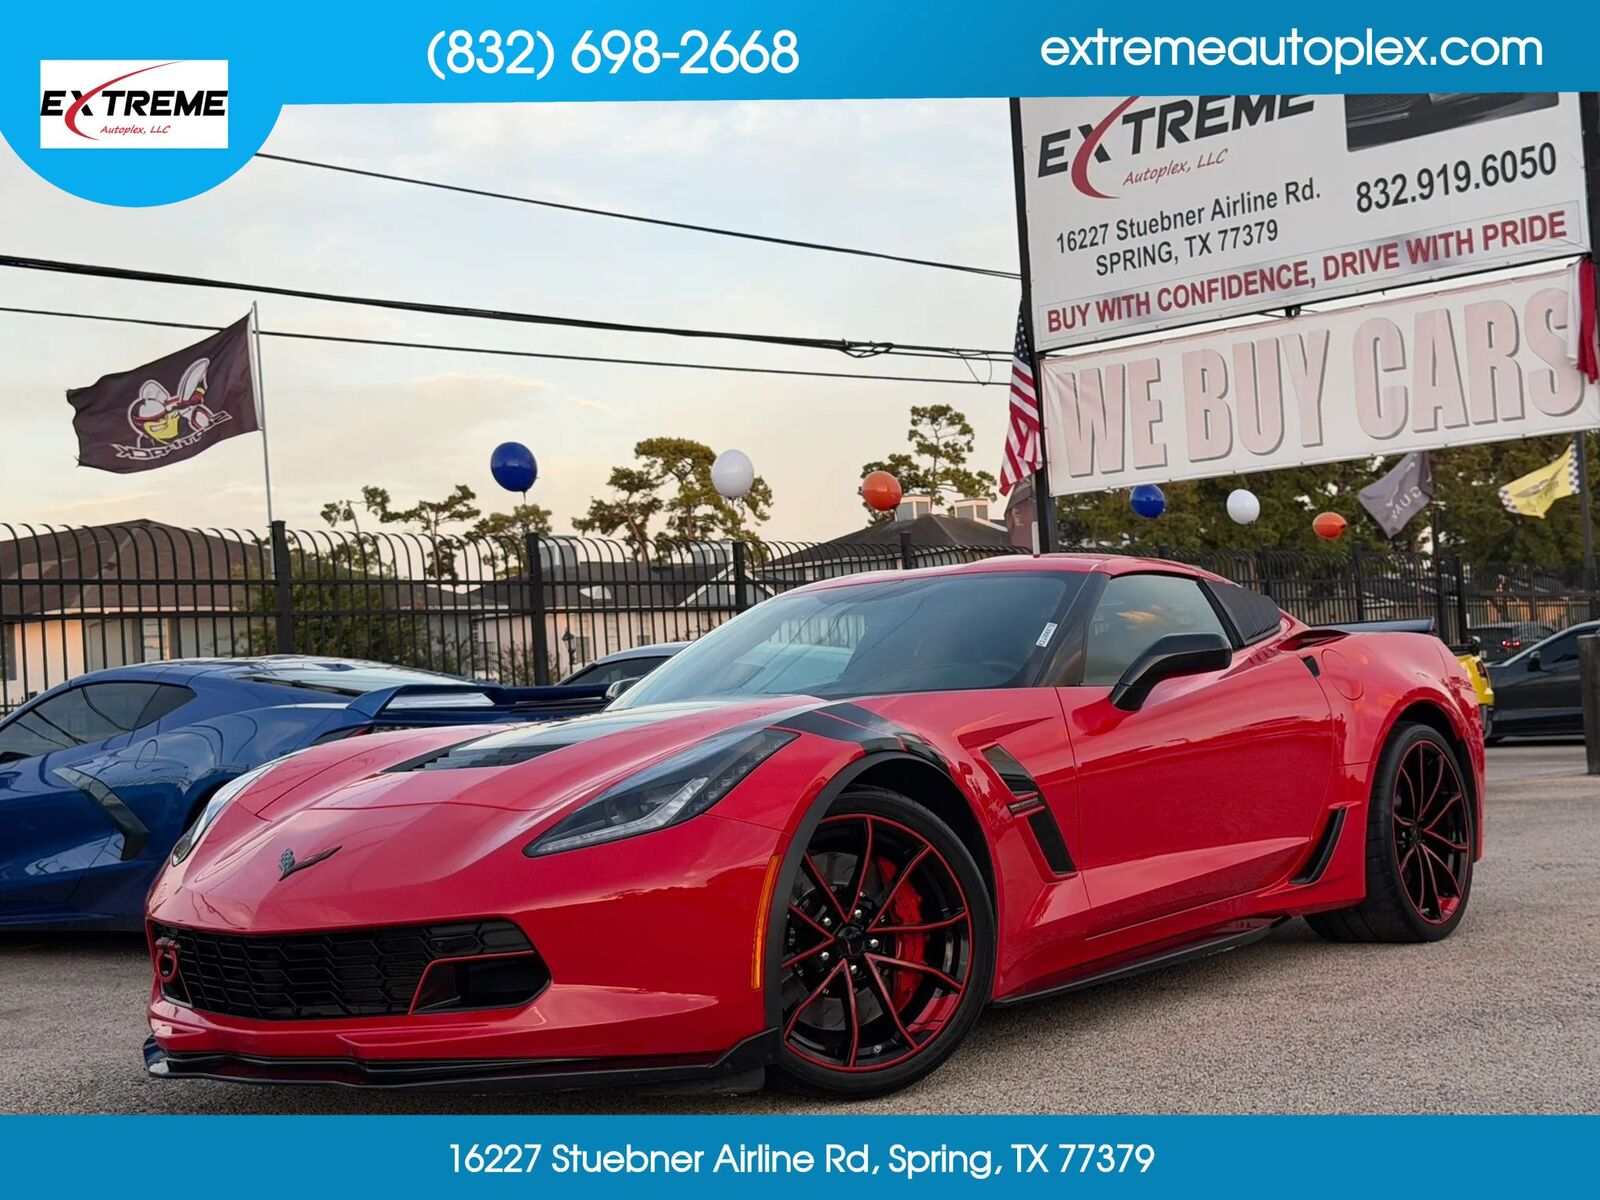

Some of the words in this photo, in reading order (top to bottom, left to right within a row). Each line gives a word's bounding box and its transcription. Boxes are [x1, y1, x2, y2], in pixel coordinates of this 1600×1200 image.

[1038, 94, 1315, 179] EXTREME
[1122, 159, 1191, 186] Autoplex,
[1197, 148, 1229, 169] LLC
[1056, 223, 1109, 254] 16227
[1116, 207, 1205, 241] Stuebner
[1211, 191, 1278, 221] Airline
[1285, 178, 1321, 204] Rd.
[1356, 142, 1557, 214] 832.919.6050
[1047, 302, 1091, 333] BUY
[1095, 291, 1151, 323] WITH
[1157, 260, 1316, 312] CONFIDENCE,
[1323, 242, 1400, 281] DRIVE
[1406, 228, 1474, 265] WITH
[1482, 210, 1567, 251] PRIDE
[1096, 241, 1179, 276] SPRING,
[1184, 234, 1212, 259] TX
[1217, 218, 1279, 251] 77379
[1060, 357, 1168, 478] WE
[1181, 329, 1331, 464] BUY
[1353, 287, 1585, 441] CARS
